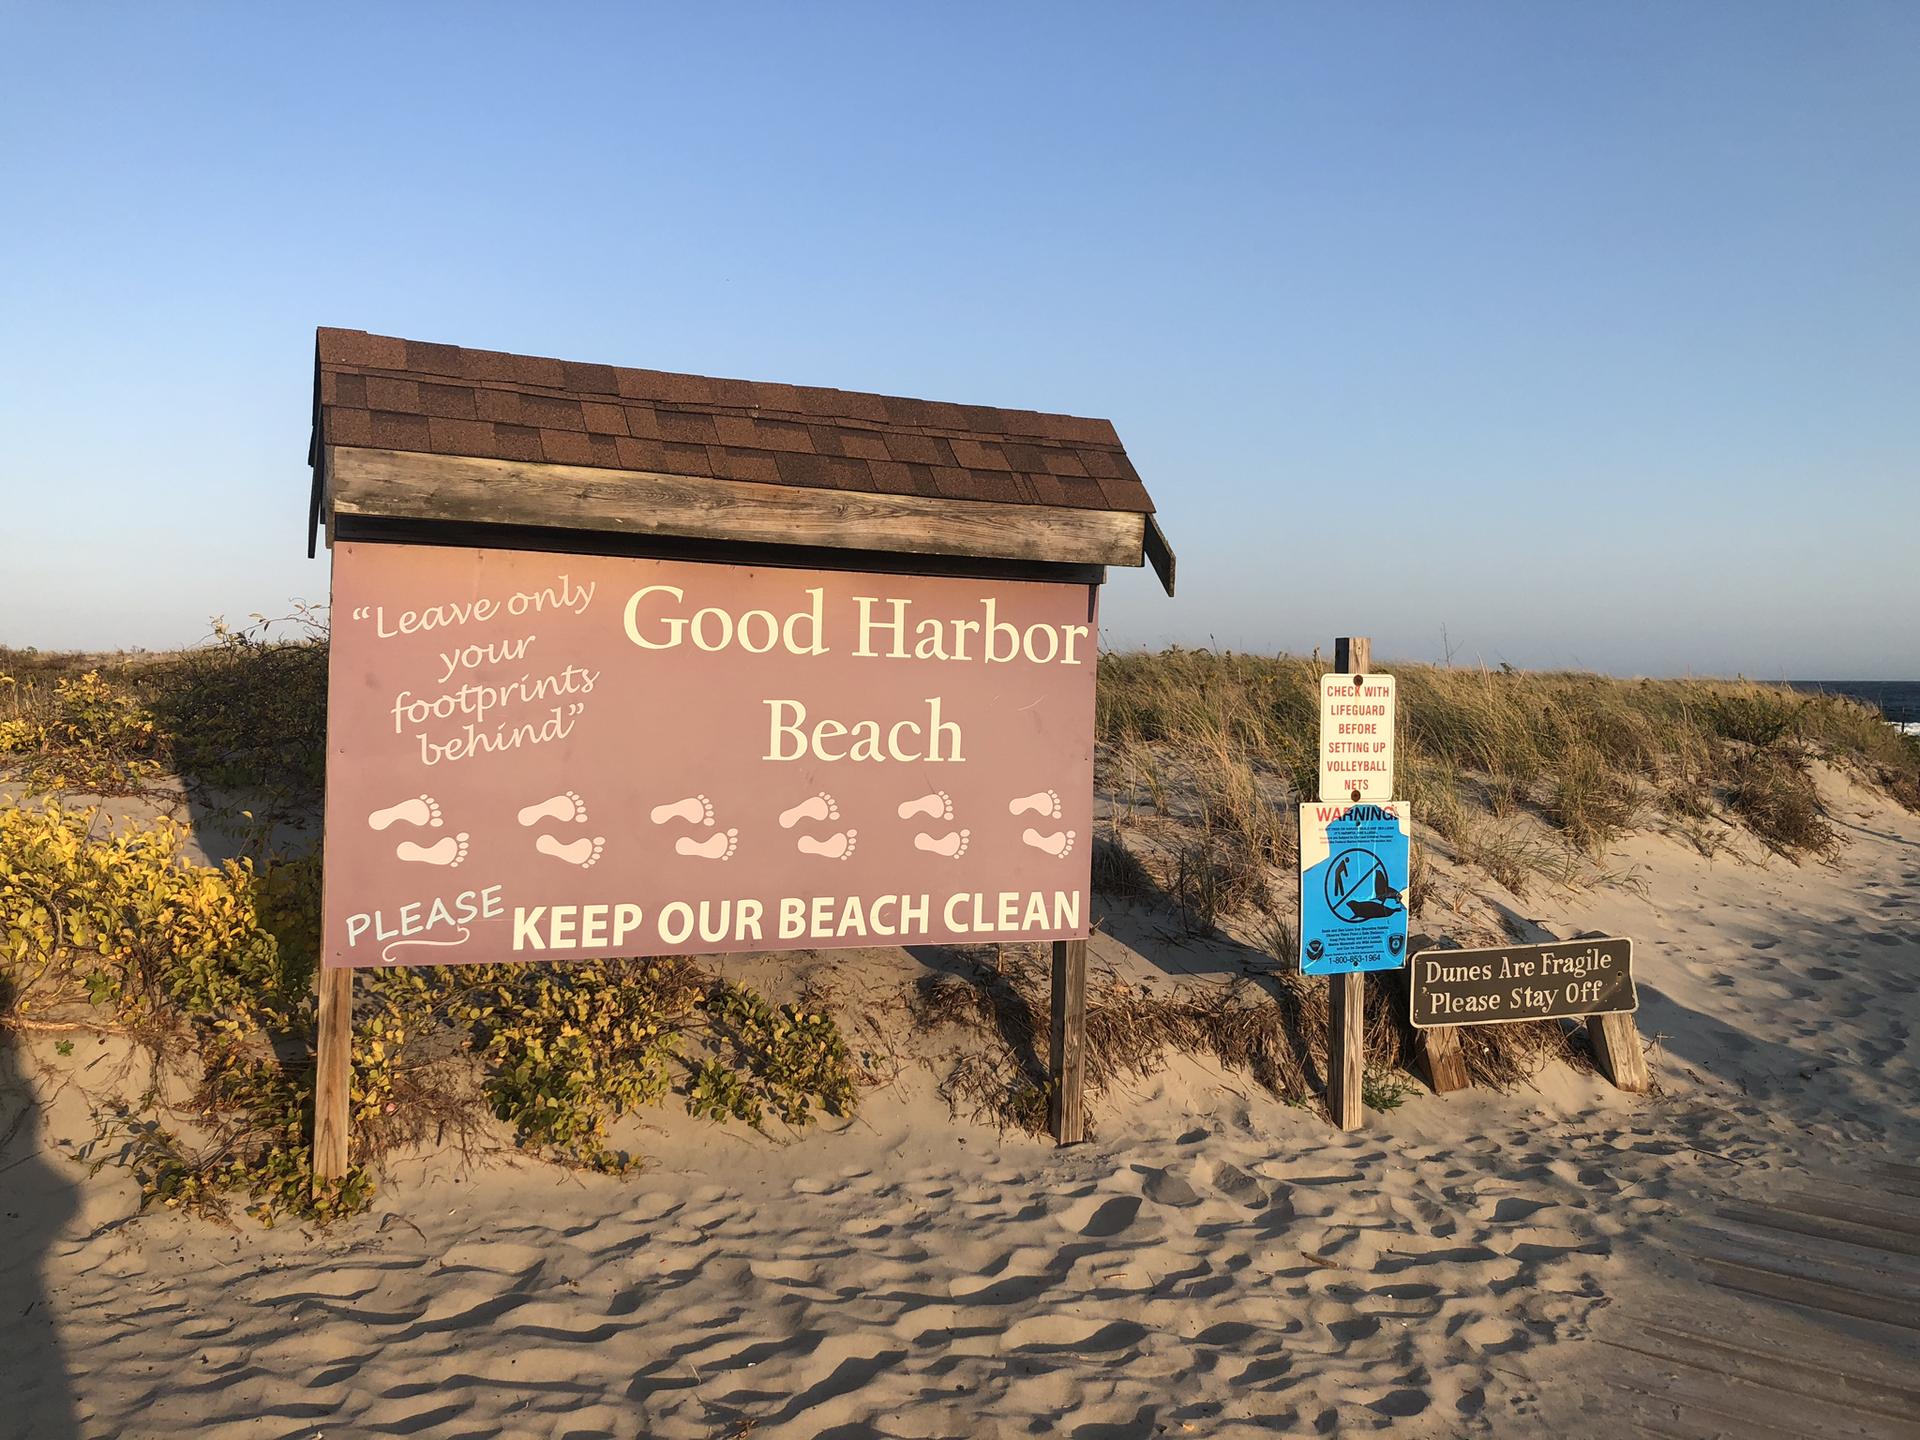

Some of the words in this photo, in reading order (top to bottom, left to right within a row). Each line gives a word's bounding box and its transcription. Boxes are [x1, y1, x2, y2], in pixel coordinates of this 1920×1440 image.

[353, 597, 500, 638] “Leave
[508, 574, 596, 614] only
[623, 585, 830, 656] Good
[851, 597, 1089, 665] Harbor
[438, 635, 536, 683] your
[390, 665, 600, 733] footprints
[1327, 686, 1361, 697] CHECK
[1364, 686, 1389, 697] WITH
[1331, 705, 1385, 716] LIFEGUARD
[416, 702, 585, 765] behind”
[762, 696, 966, 762] Beach
[1339, 724, 1377, 734] BEFORE
[1328, 742, 1369, 753] SETTING
[1373, 742, 1386, 753] UP
[1327, 761, 1387, 772] VOLLEYBALL
[1344, 779, 1369, 790] NETS
[345, 884, 504, 946] PLEASE
[513, 903, 643, 950] KEEP
[657, 899, 764, 945] OUR
[778, 894, 930, 939] BEACH
[943, 890, 1080, 933] CLEAN
[1425, 961, 1492, 984] Dunes
[1499, 956, 1535, 979] Are
[1541, 948, 1612, 978] Fragile
[1430, 992, 1500, 1014] Please
[1510, 986, 1559, 1013] Stay
[1566, 980, 1604, 1004] Off
